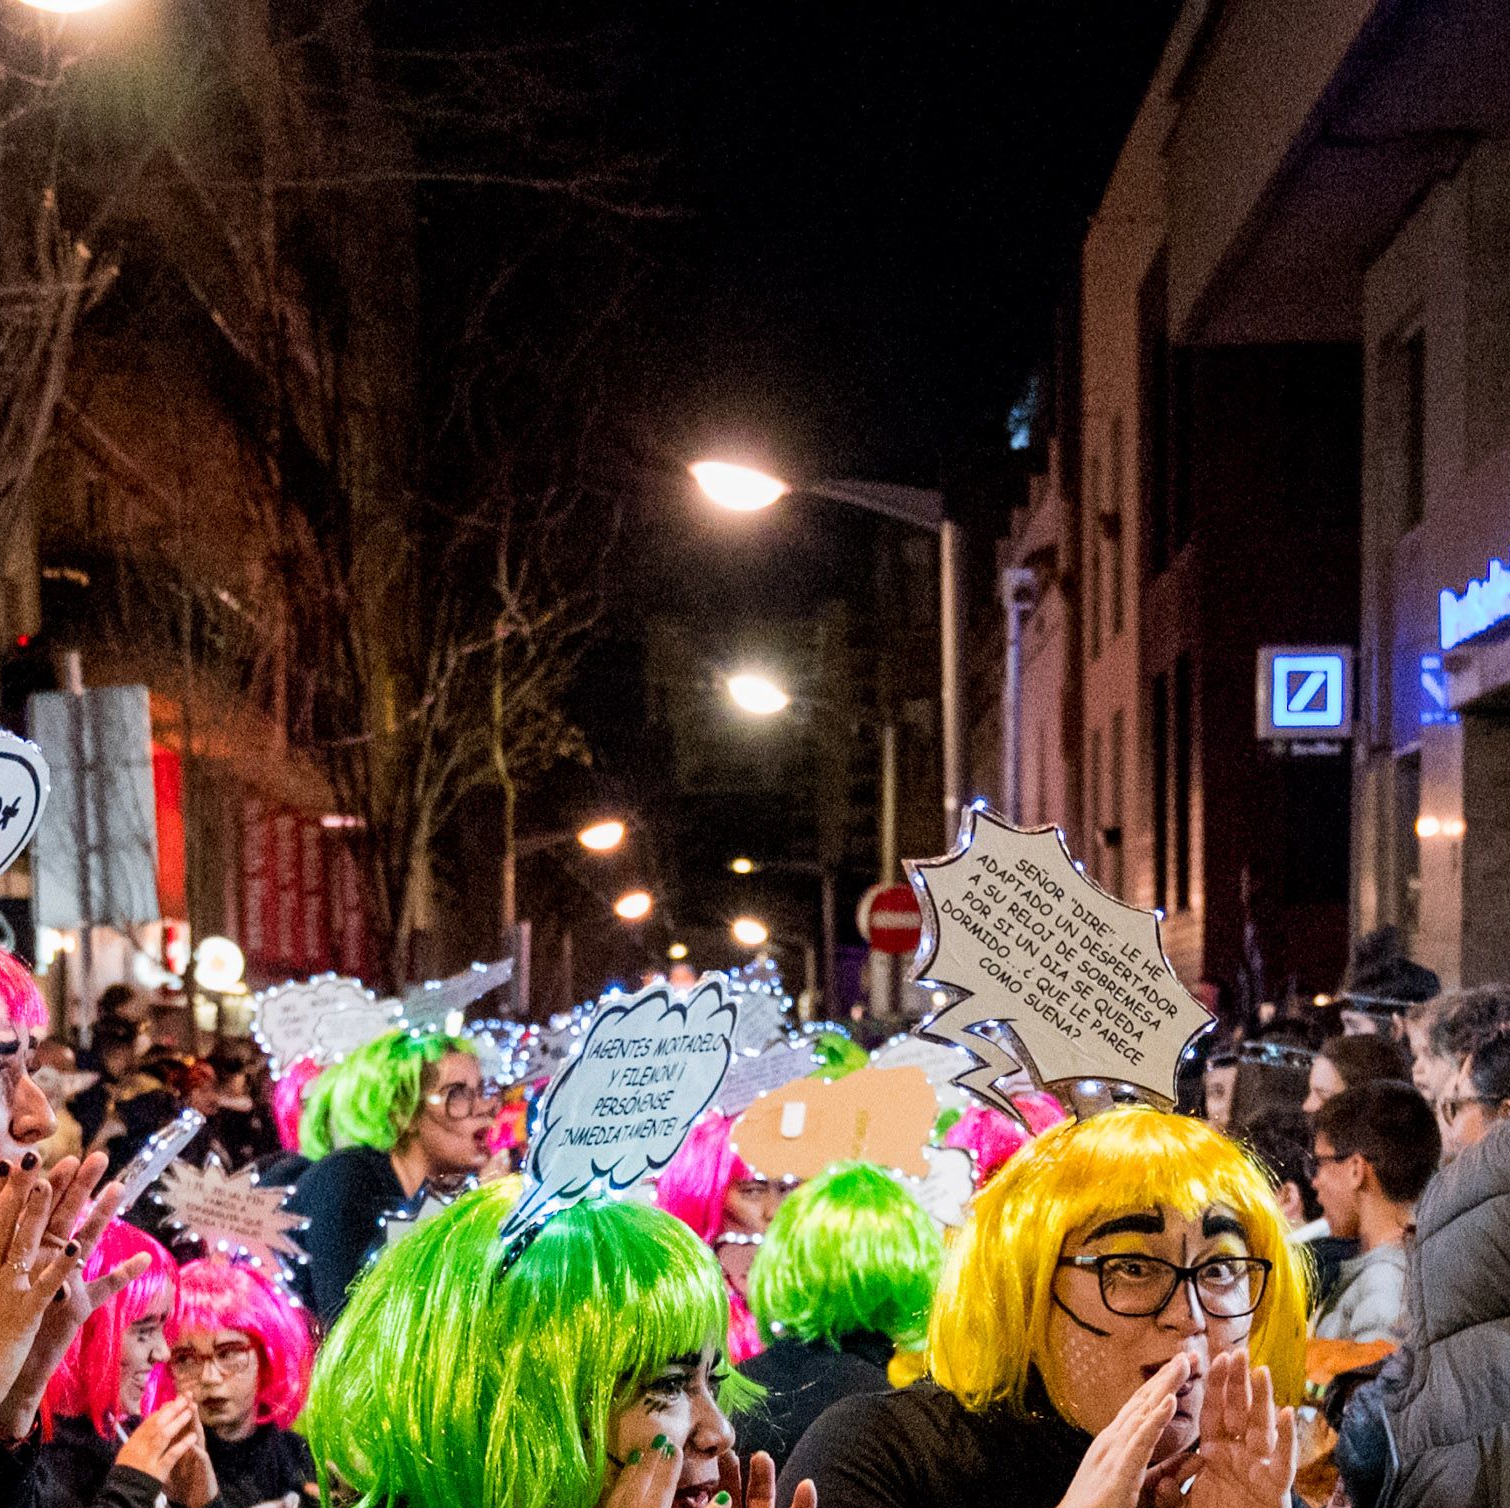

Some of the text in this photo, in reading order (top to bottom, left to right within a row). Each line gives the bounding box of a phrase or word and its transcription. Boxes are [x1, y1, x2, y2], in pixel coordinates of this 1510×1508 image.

[961, 891, 1145, 1043] POR SI UN DIA SE QUEDA
[968, 874, 1163, 1032] A SU RELOJ DE SOBREMESA
[976, 854, 1179, 1020] ADAPTADO UN DESPERTADOR
[1015, 858, 1065, 902] SEÑOR
[1120, 942, 1142, 964] LE
[1141, 959, 1165, 982] HE
[979, 957, 1083, 1041] COMO SUENA?
[1035, 976, 1073, 1008] QUE
[1069, 1002, 1091, 1024] LE
[1090, 1020, 1146, 1067] PARECE
[607, 1068, 620, 1088] Y
